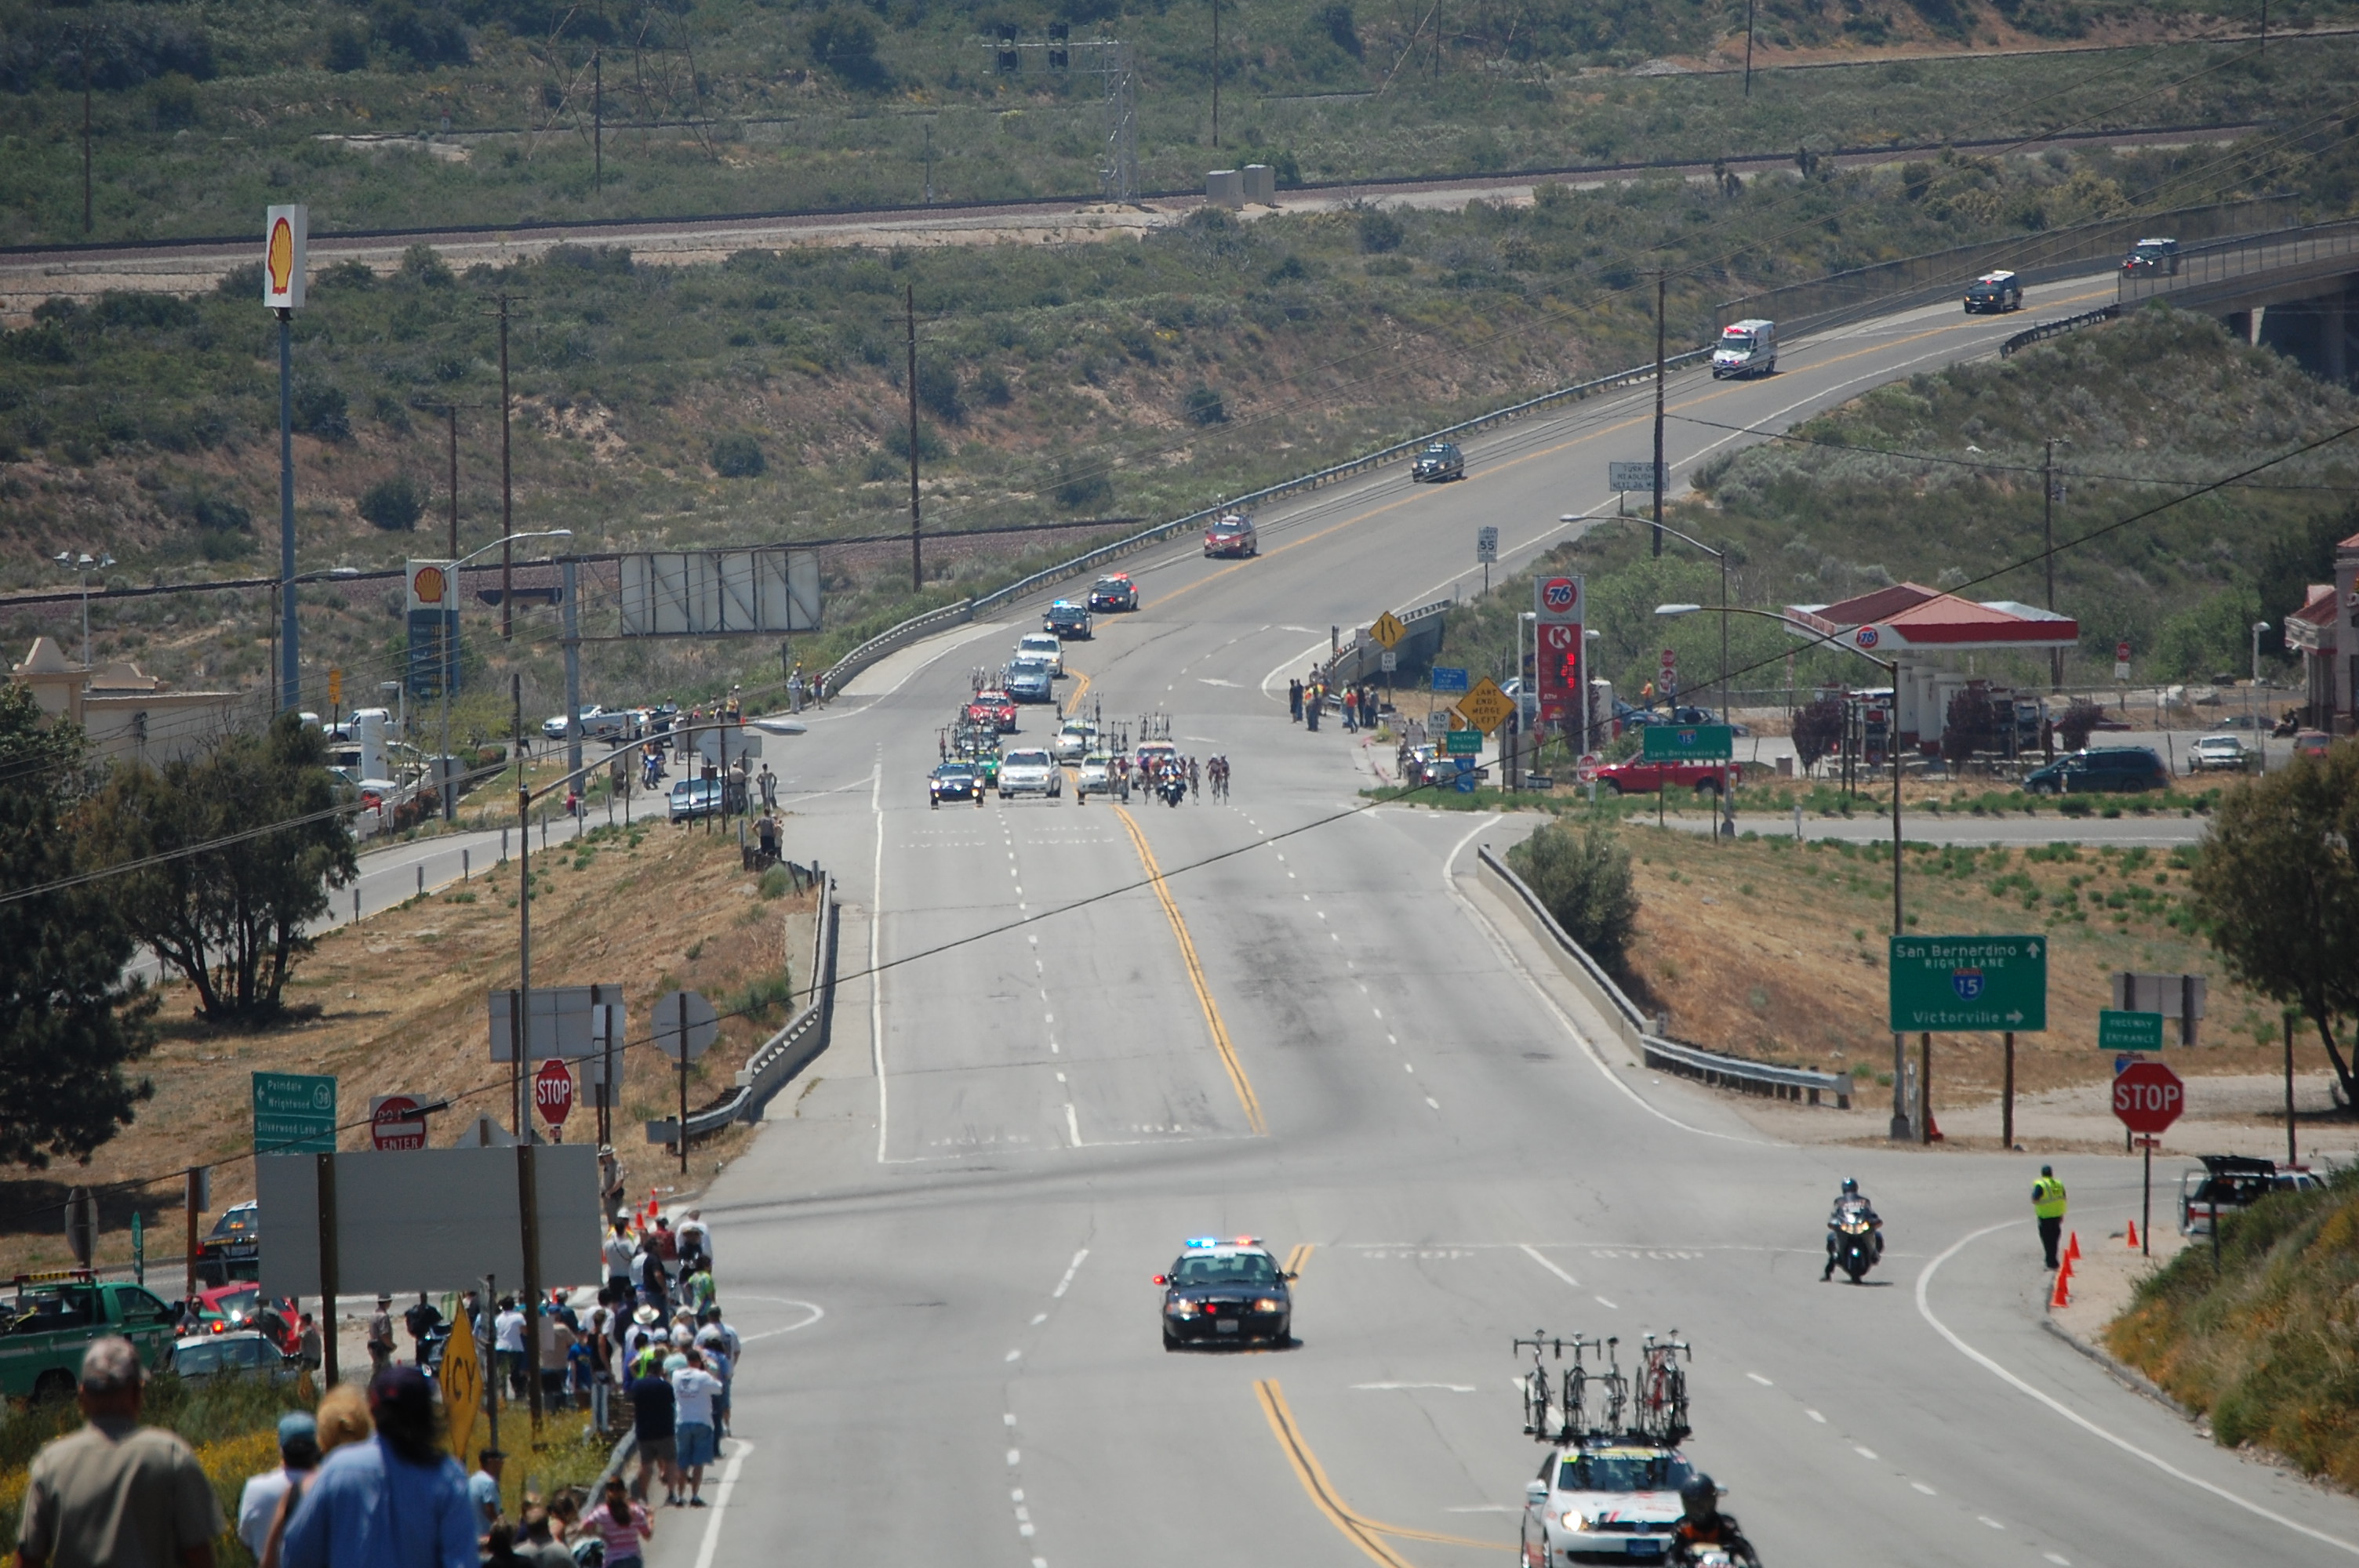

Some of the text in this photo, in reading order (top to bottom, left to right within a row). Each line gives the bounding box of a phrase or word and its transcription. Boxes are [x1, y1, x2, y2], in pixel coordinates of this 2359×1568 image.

[1480, 540, 1495, 550] 55
[1547, 584, 1572, 605] 76
[1549, 626, 1572, 649] K
[1859, 630, 1876, 644] 76
[1682, 735, 1692, 744] 15
[1896, 945, 2017, 958] San Bernardino
[1925, 958, 2005, 969] RIGHT LANE
[1959, 979, 1979, 995] 15
[1913, 1011, 2000, 1023] Victorville
[2110, 1019, 2154, 1029] FREEWAY
[2106, 1033, 2155, 1044] ENTRANCE
[267, 1080, 303, 1092] Palmdale
[537, 1080, 569, 1105] STOP
[315, 1092, 329, 1105] 138
[2115, 1083, 2180, 1111] STOP
[267, 1098, 311, 1110] Wrightwood
[257, 1122, 317, 1135] Silverwood Lake
[382, 1138, 419, 1151] ENTER
[445, 1354, 475, 1403] ICY
